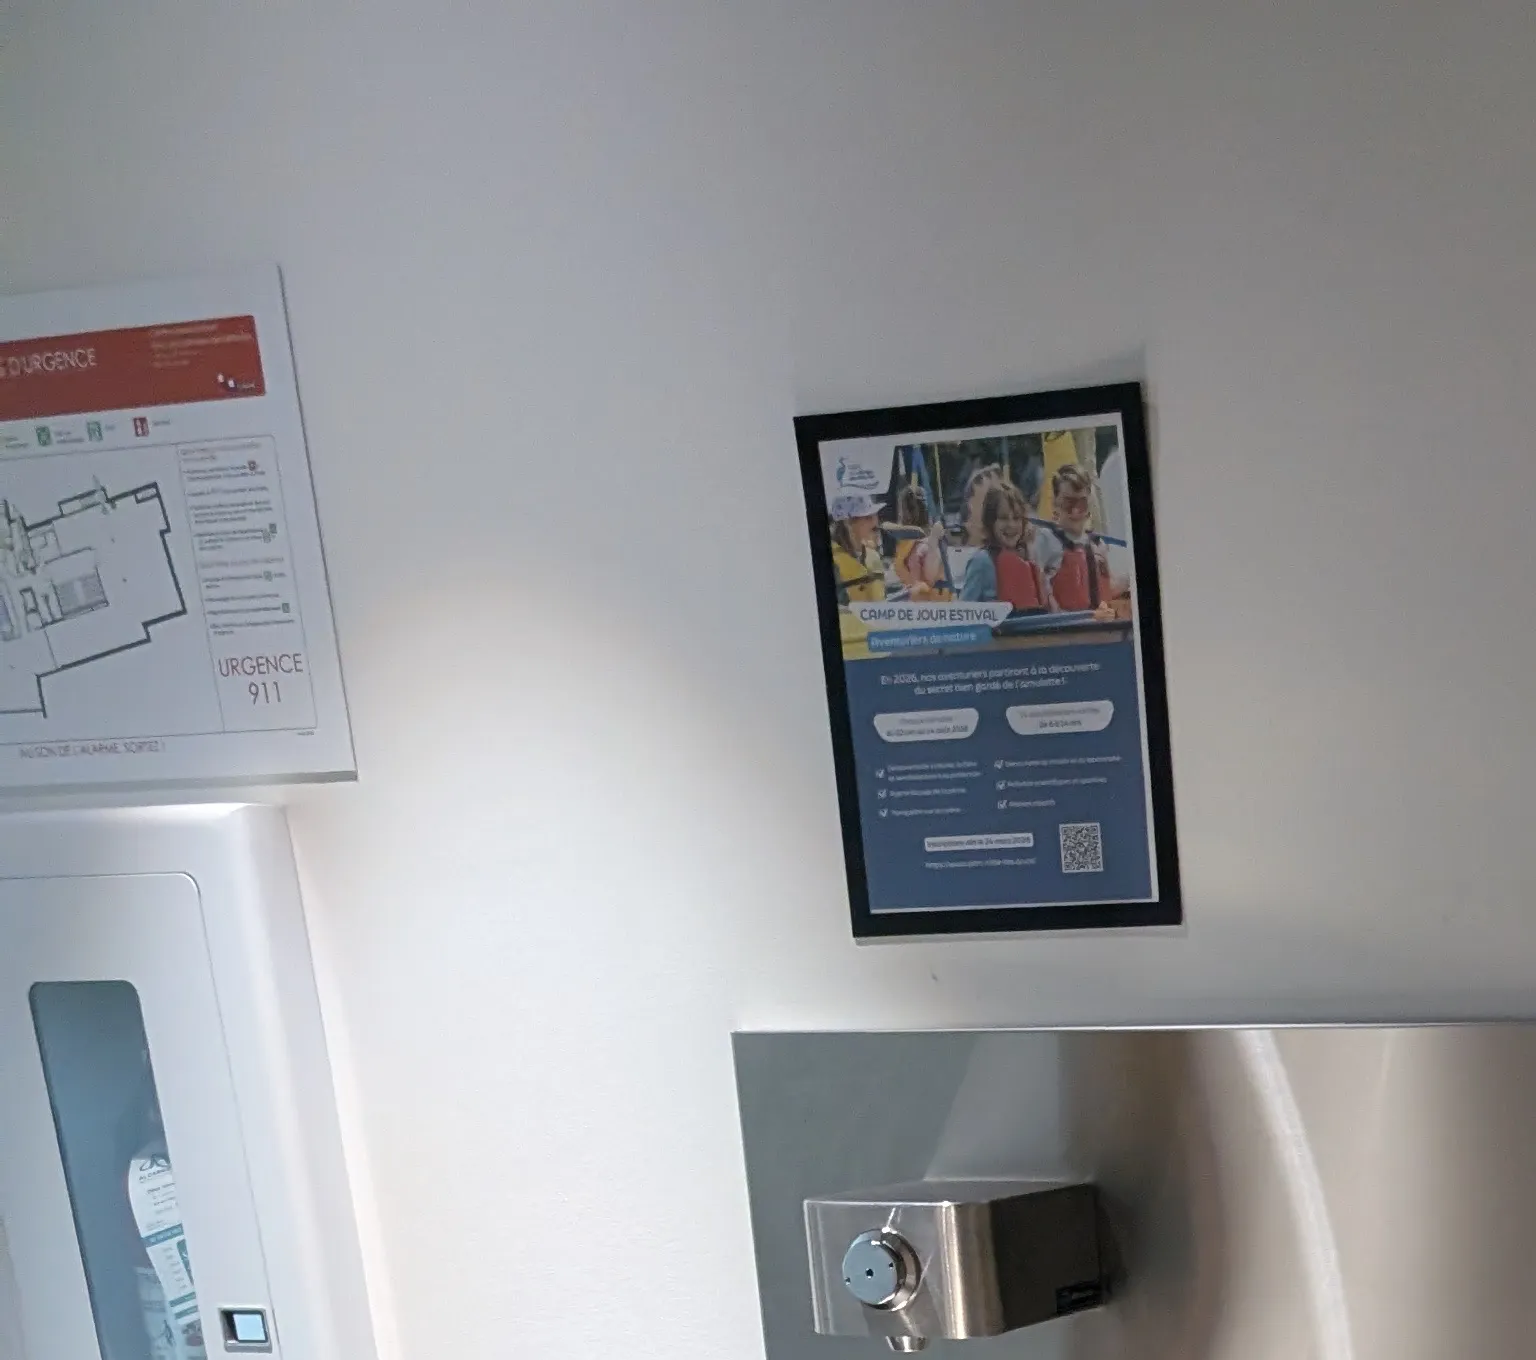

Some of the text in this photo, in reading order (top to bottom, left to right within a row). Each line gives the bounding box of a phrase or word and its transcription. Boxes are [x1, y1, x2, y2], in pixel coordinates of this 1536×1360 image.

[8, 347, 96, 375] D'URGENCE
[860, 608, 999, 622] CAMP DE JOUR ESTIVAL
[218, 653, 304, 678] URGENCE
[248, 680, 282, 705] 911
